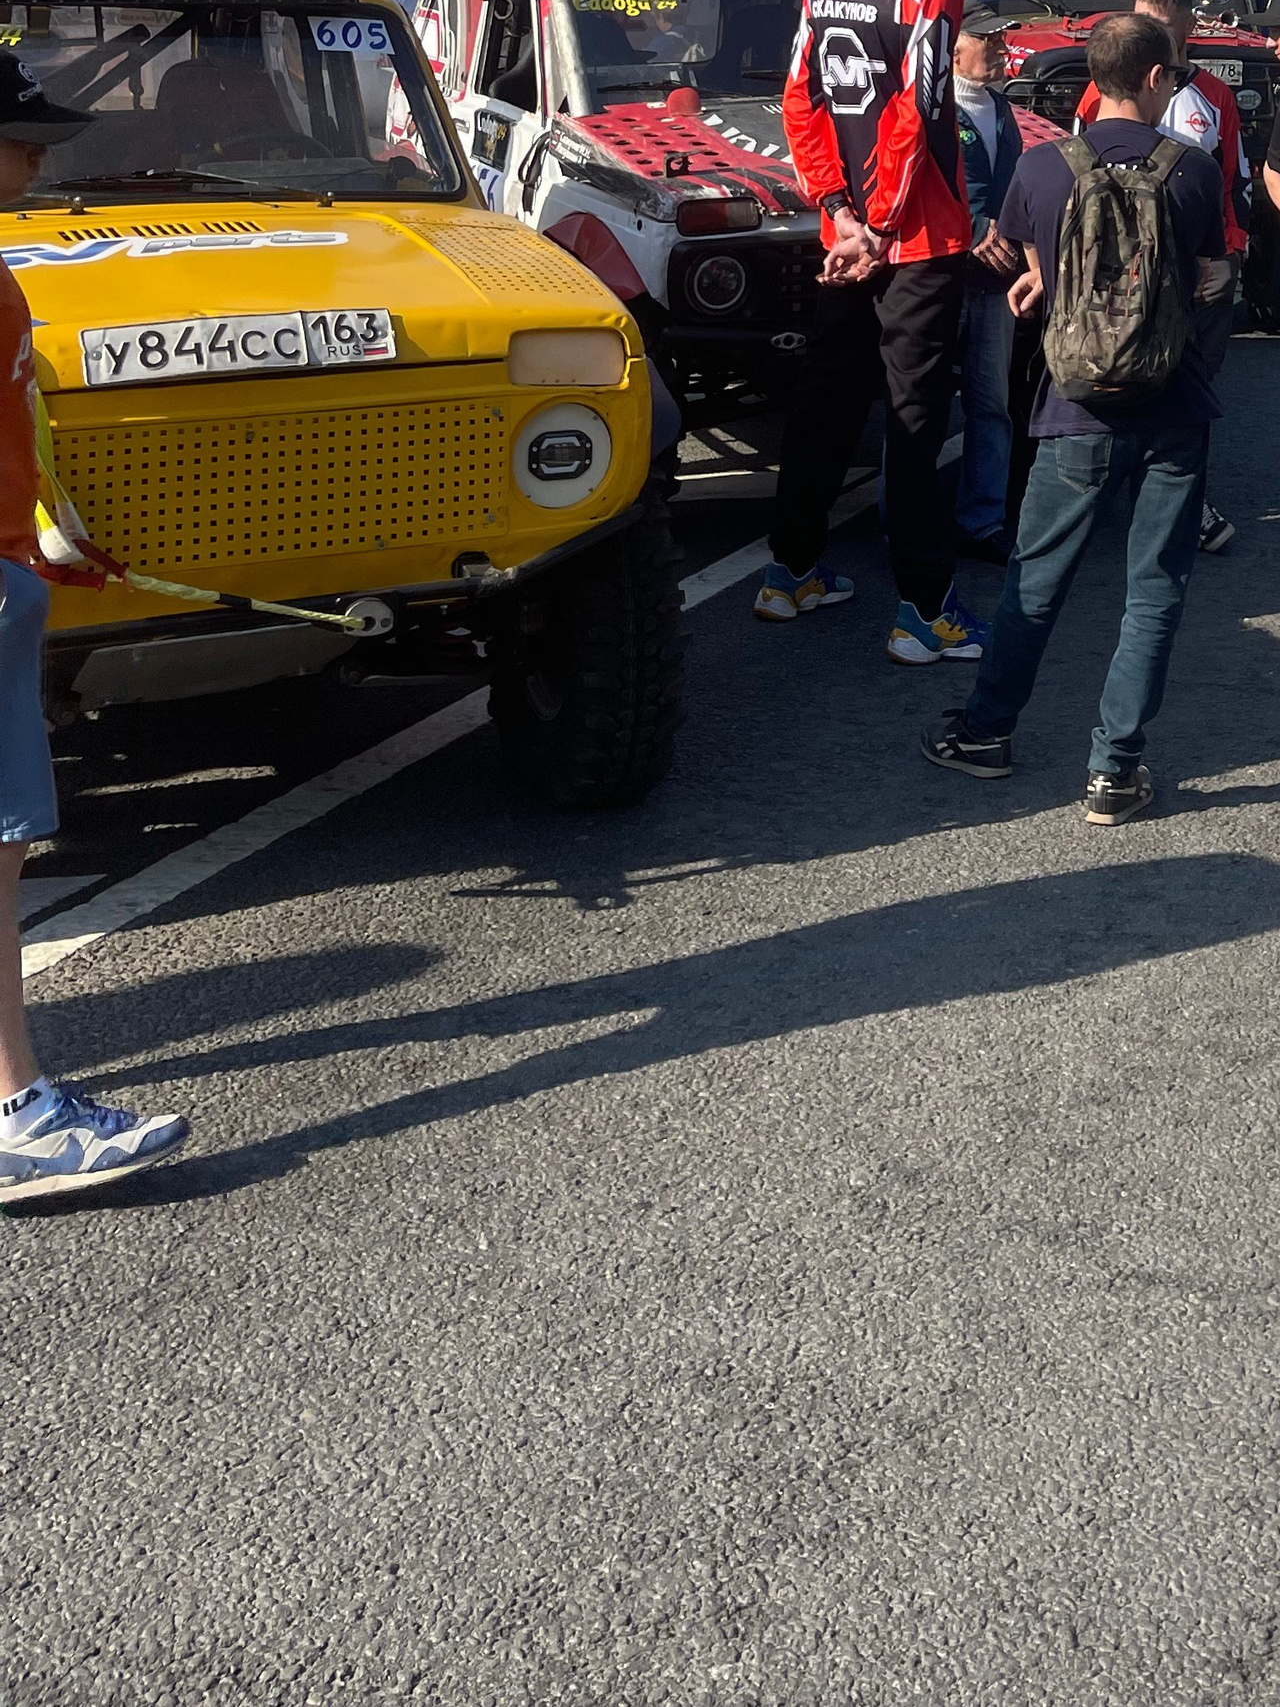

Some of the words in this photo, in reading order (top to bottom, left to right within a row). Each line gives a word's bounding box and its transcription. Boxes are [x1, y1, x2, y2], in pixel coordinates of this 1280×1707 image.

[317, 20, 387, 50] 605
[139, 232, 338, 254] parts
[104, 322, 300, 375] У844СС
[310, 312, 379, 344] 163
[328, 344, 362, 357] RUS
[3, 1087, 43, 1117] ILA
